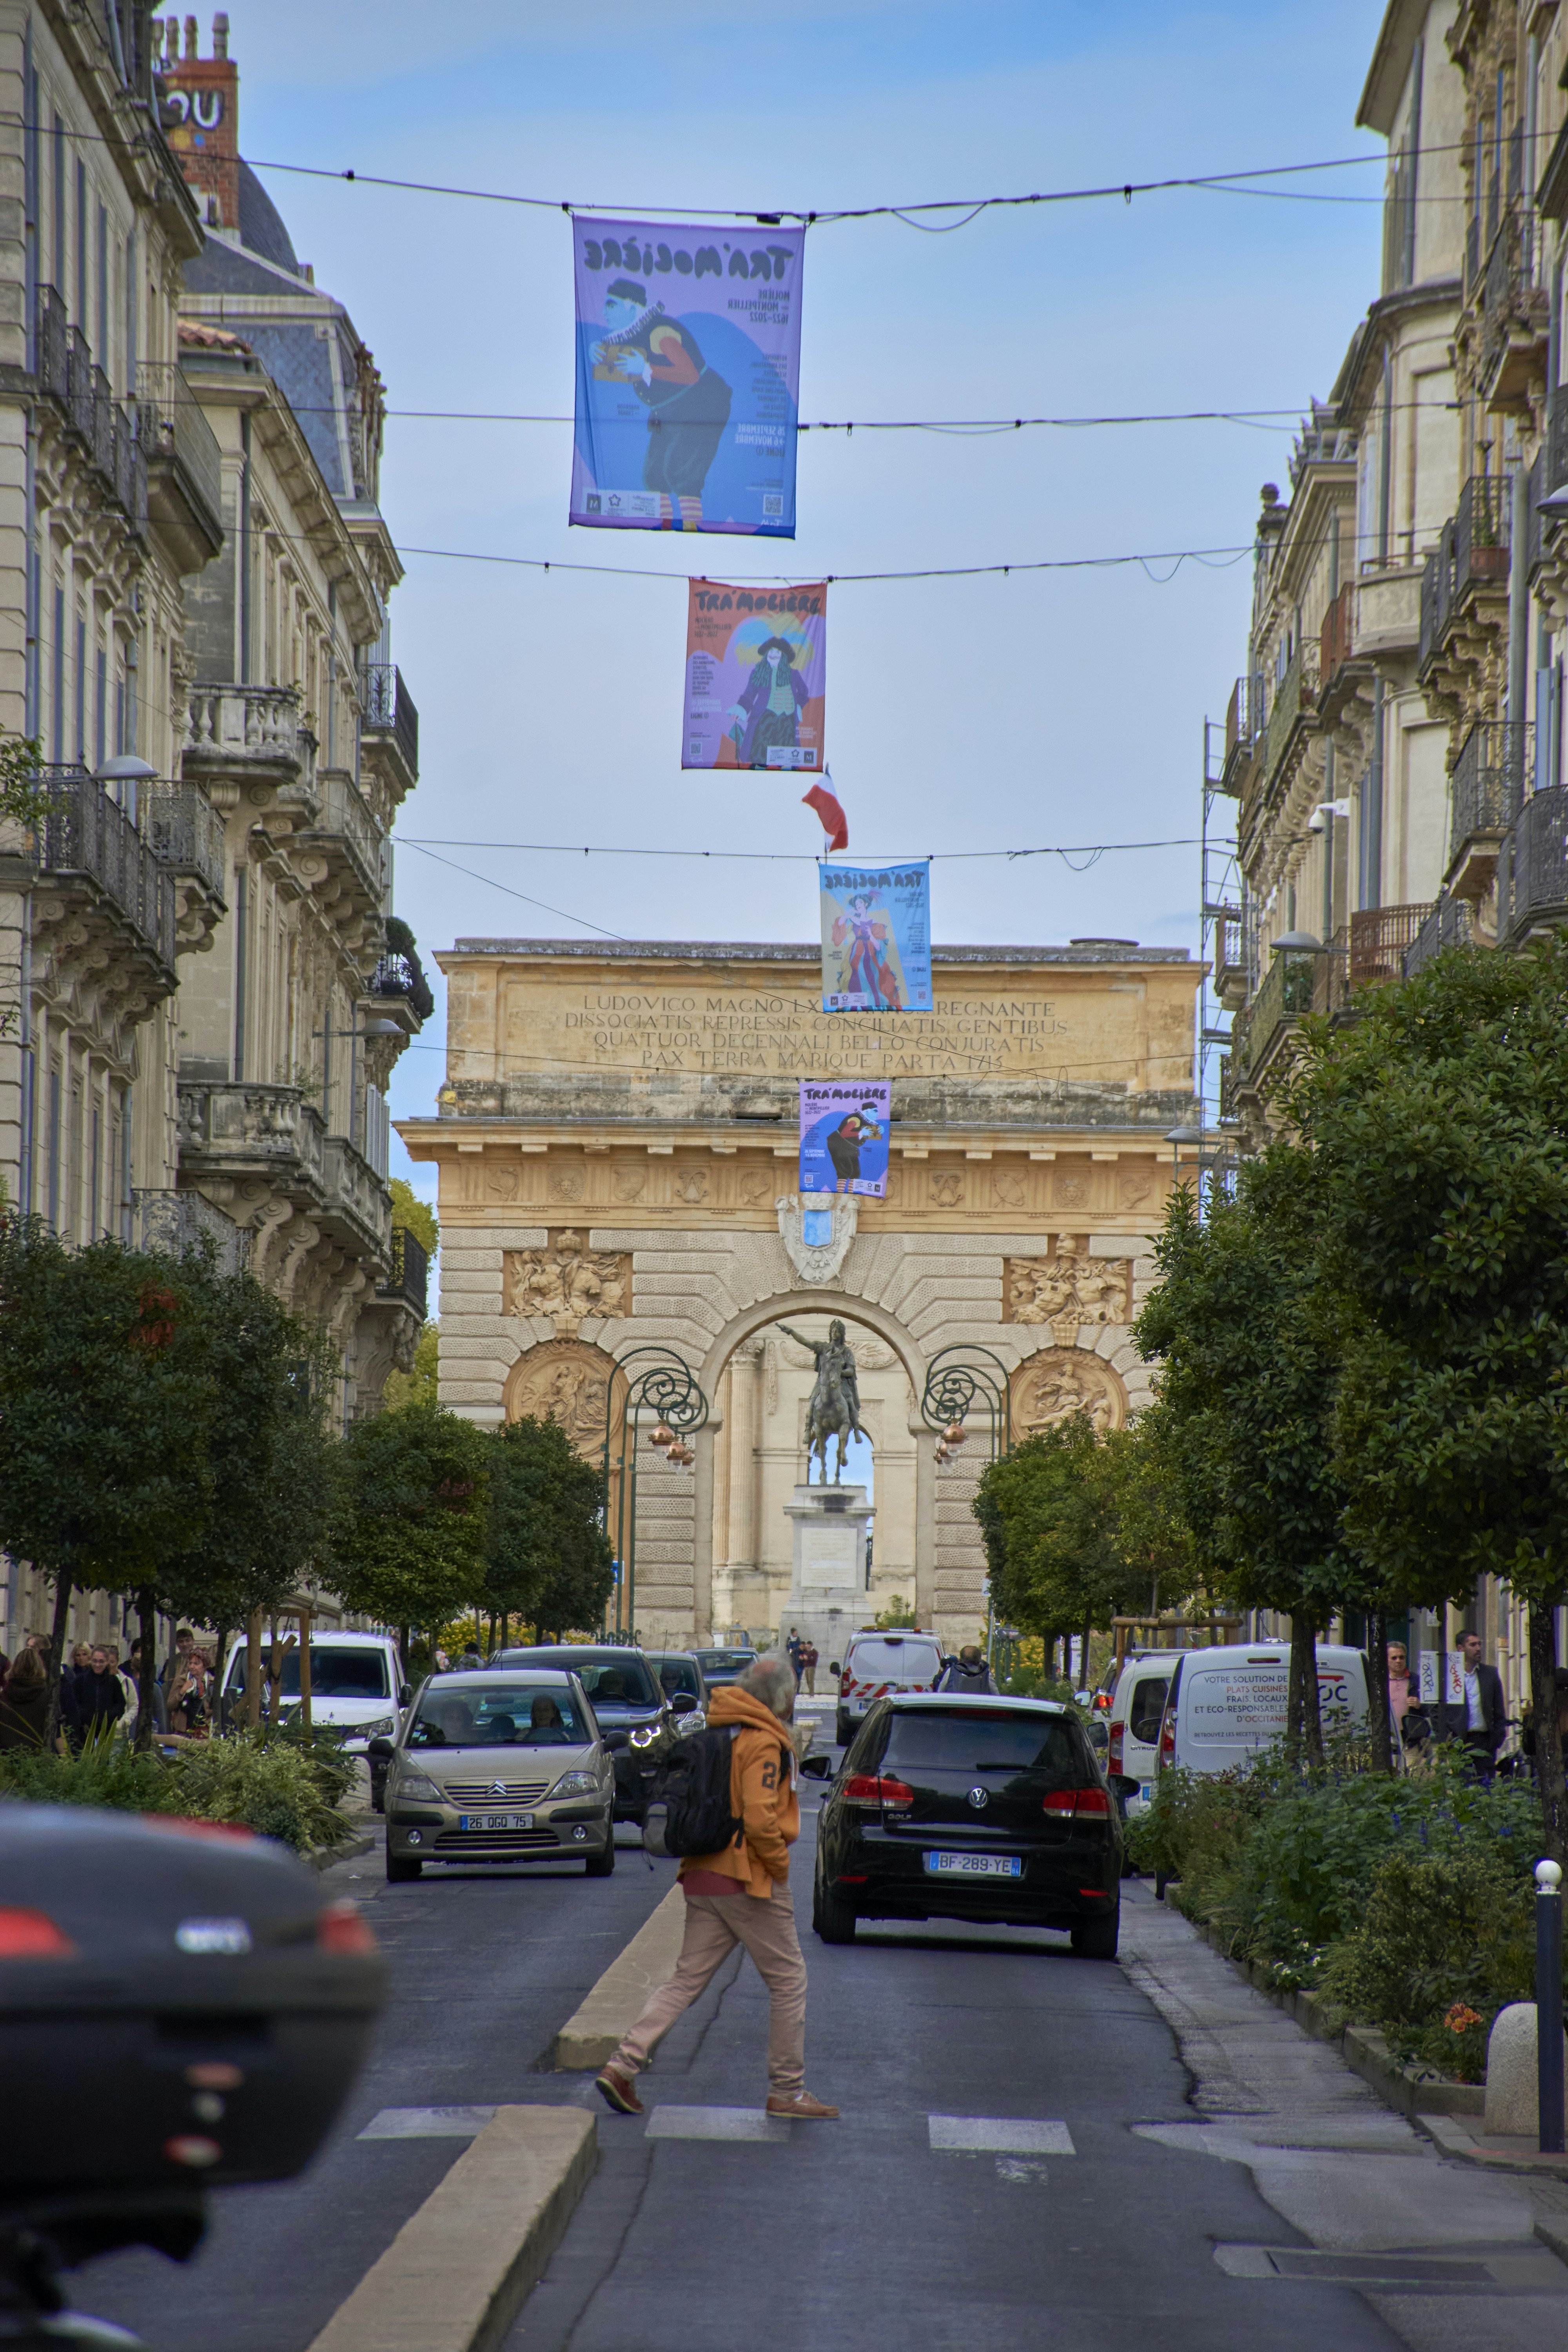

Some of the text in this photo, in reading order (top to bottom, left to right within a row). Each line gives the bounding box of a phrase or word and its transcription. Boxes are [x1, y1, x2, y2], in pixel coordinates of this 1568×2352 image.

[584, 996, 695, 1012] LUDOVICO
[706, 998, 783, 1013] MAGNO
[937, 1001, 1056, 1017] REGNANTE
[565, 1013, 1067, 1035] DISSOCIATIS REPRESSIS CONCILIATIS GENTIBUS
[594, 1031, 1045, 1053] QUATUOR DECENNALI BELLO CONJURATIS
[642, 1050, 1003, 1071] PAX TERRA MARIQUE PARTA 1715
[1252, 1684, 1288, 1693] CUISINÉS
[1207, 1705, 1289, 1713] ÉCO-RESPONSABLES
[762, 1761, 777, 1789] 2
[469, 1816, 526, 1829] 26 QGQ 75
